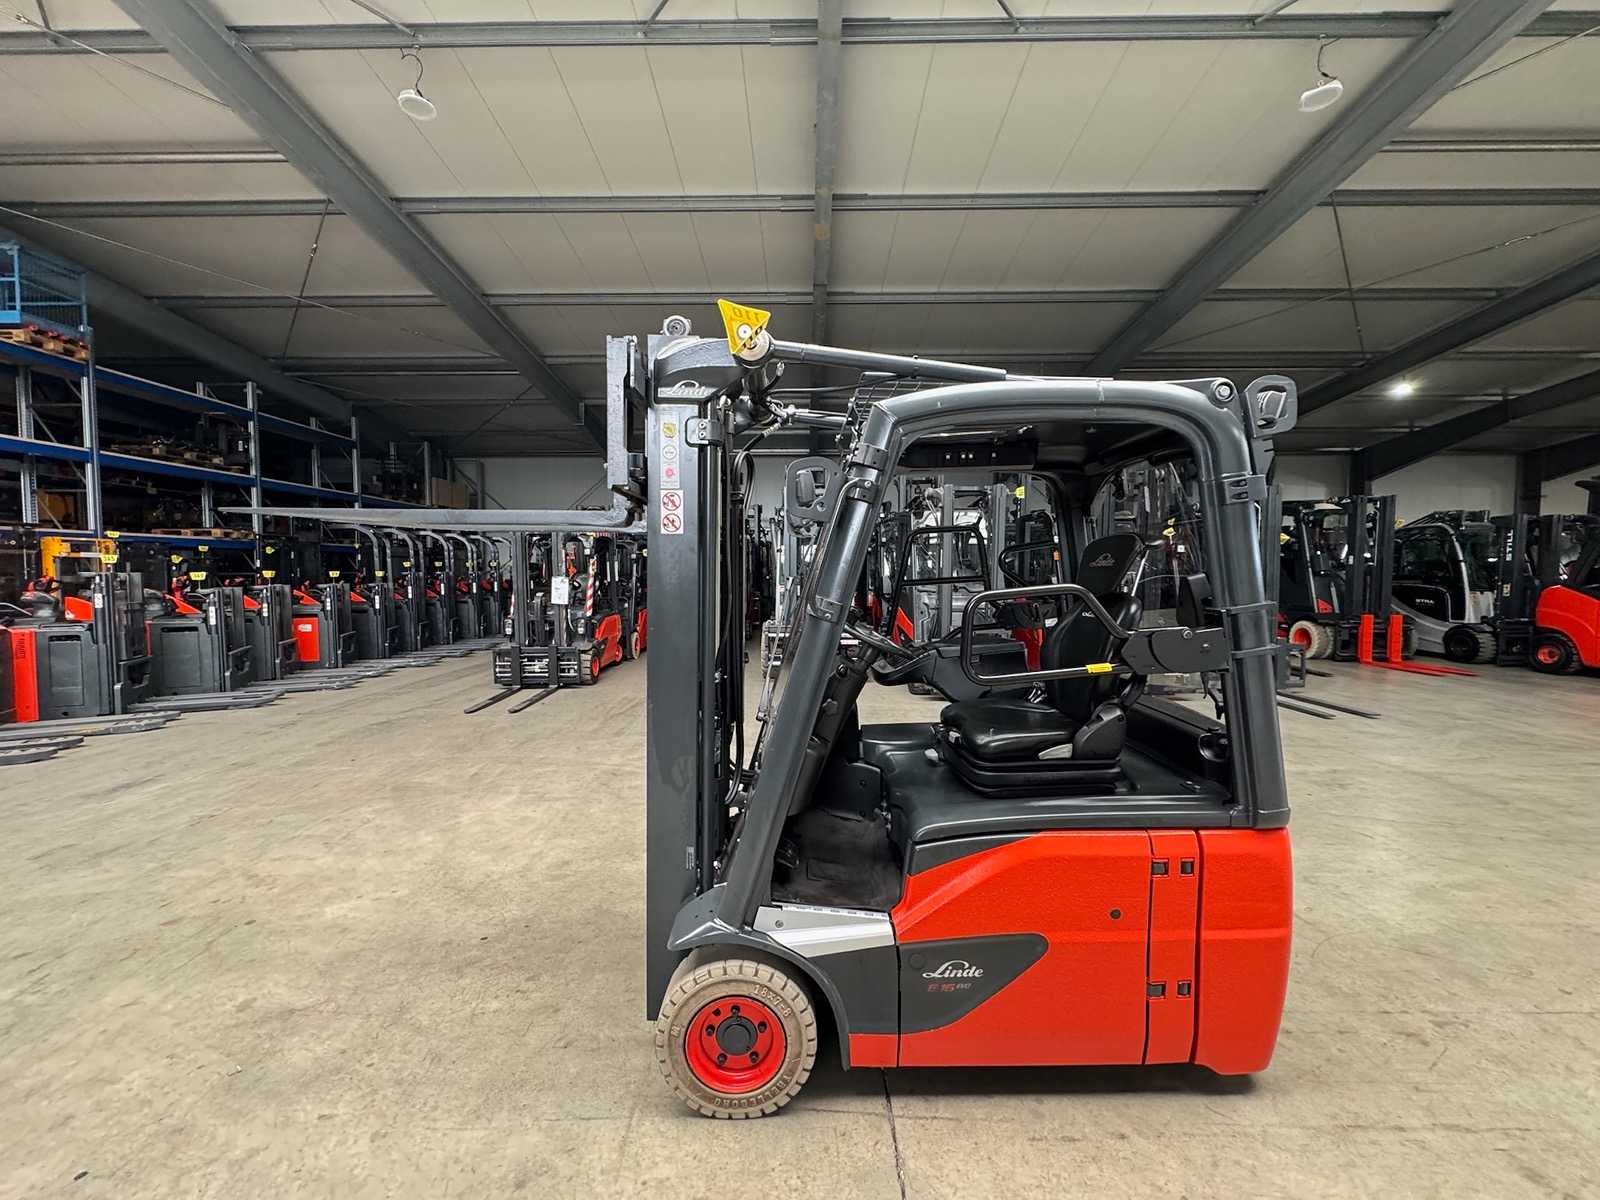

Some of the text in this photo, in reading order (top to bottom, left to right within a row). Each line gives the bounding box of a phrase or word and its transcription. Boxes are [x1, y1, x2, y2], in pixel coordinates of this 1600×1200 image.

[660, 379, 713, 396] Linde
[1505, 529, 1514, 561] STILL
[922, 960, 984, 978] Linde
